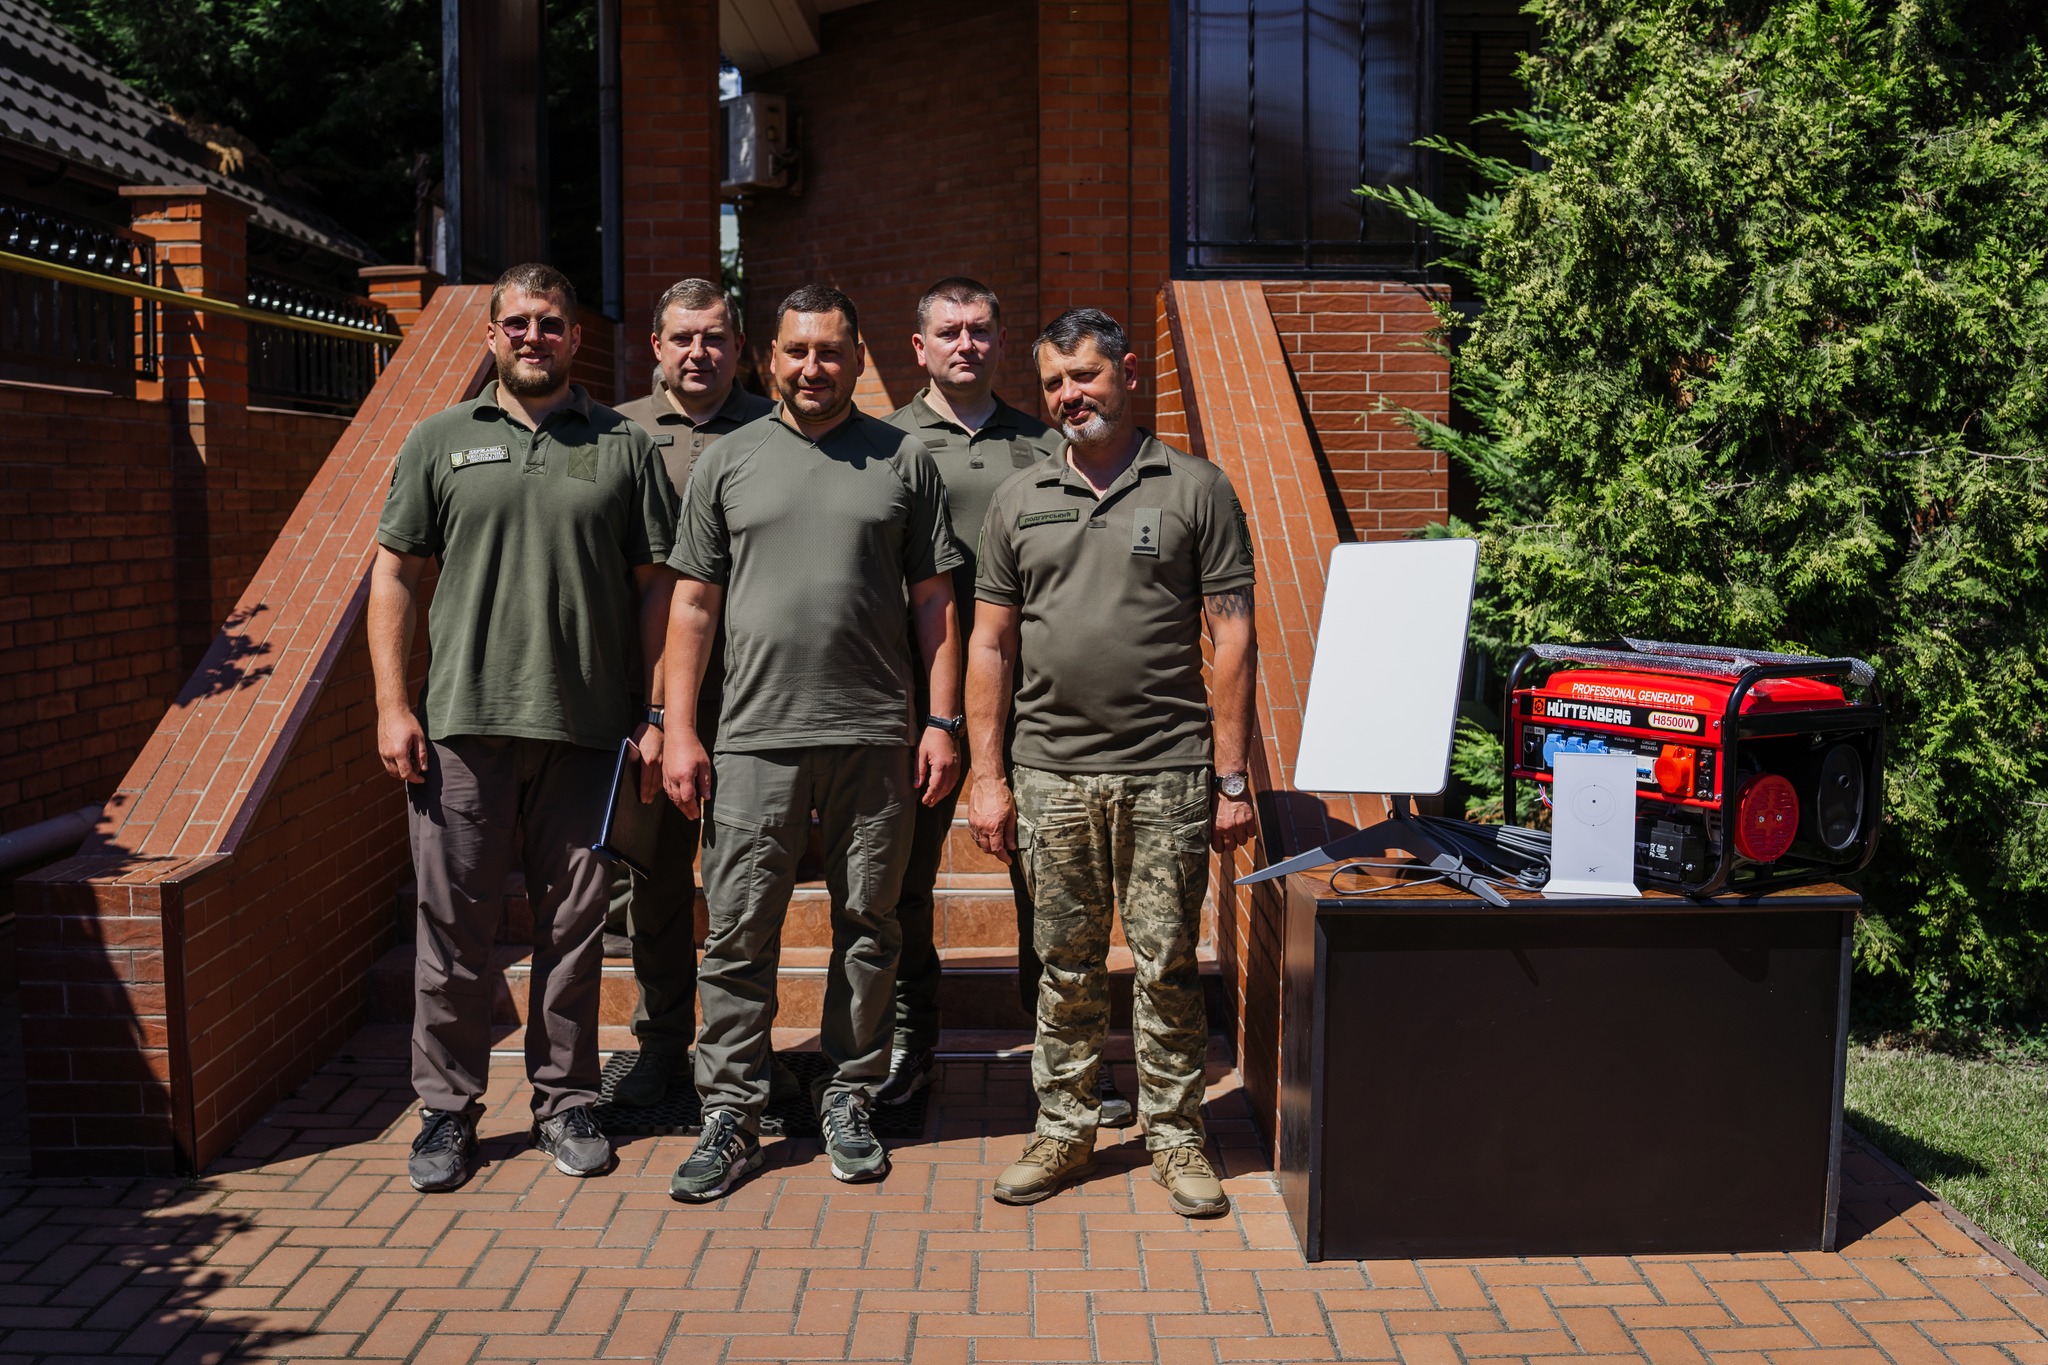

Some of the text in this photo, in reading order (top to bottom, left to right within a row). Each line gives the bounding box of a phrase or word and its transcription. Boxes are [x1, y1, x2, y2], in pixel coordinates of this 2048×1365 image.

[1572, 683, 1695, 706] PROFESSIONAL GENERATOR
[1546, 699, 1632, 726] HÜTTENBERG
[1653, 714, 1695, 729] H8500W
[1640, 744, 1659, 752] BREAKER
